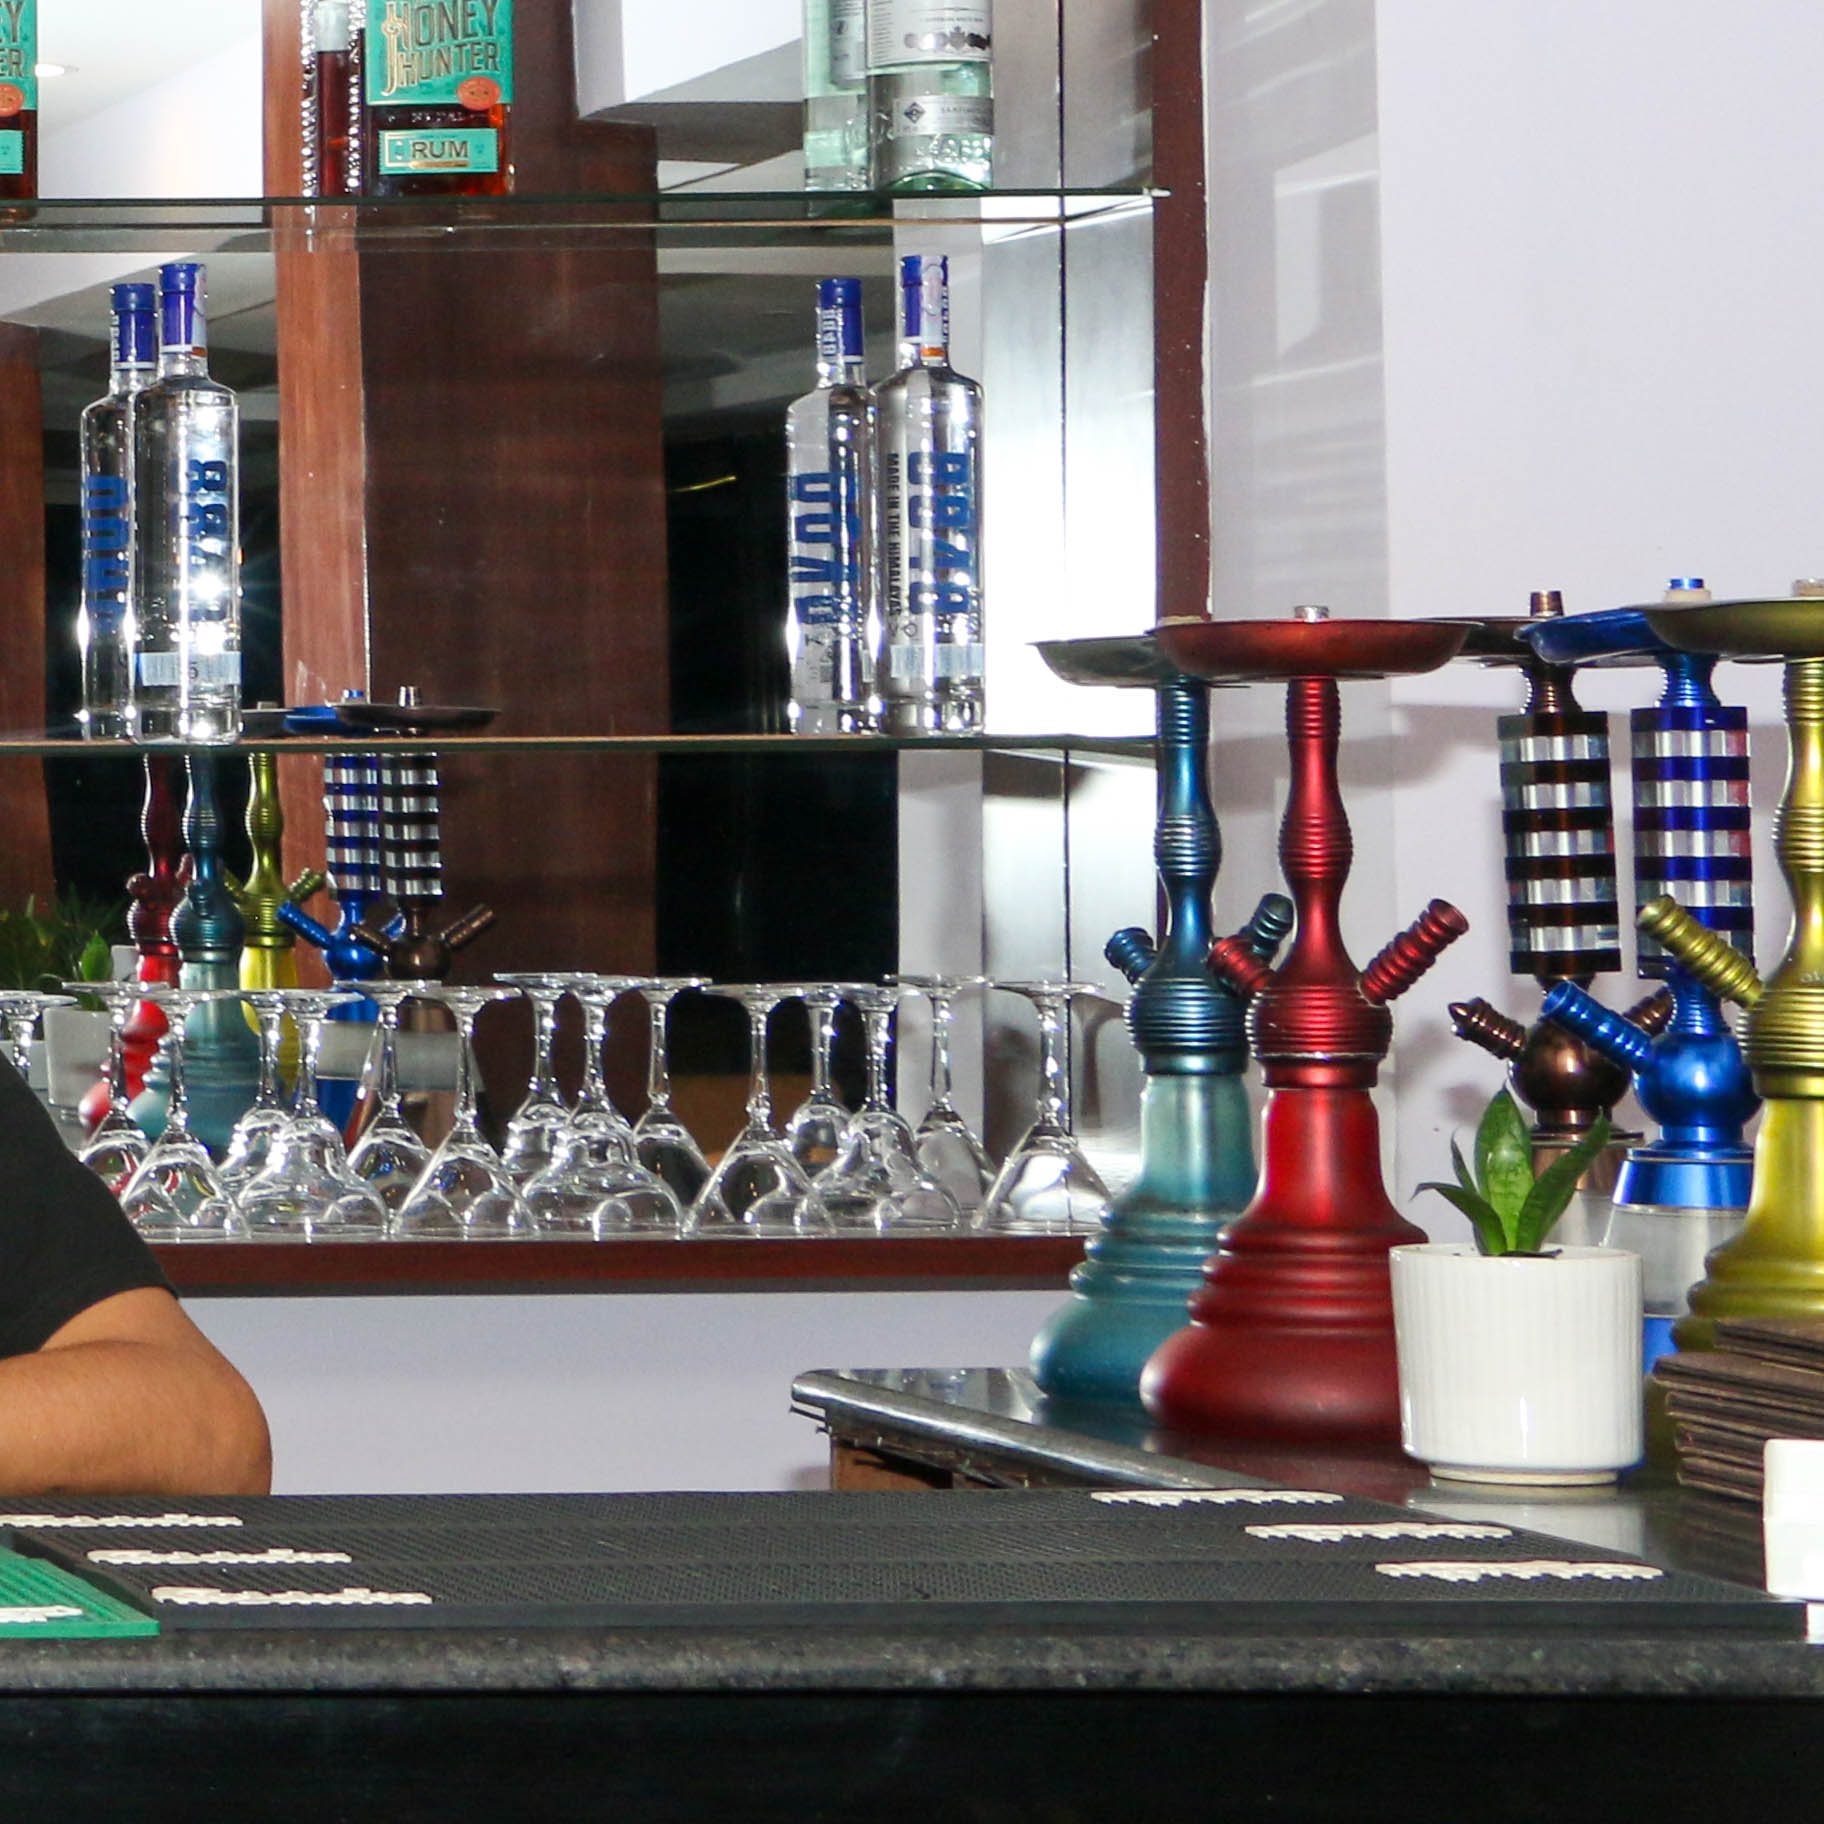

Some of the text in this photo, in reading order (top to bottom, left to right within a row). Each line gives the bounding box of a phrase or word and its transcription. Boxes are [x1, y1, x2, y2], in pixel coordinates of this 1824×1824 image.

[395, 41, 501, 89] HUNTER
[411, 141, 469, 159] RUM
[887, 452, 902, 492] MADE
[887, 496, 901, 510] IN
[887, 514, 901, 538] THE
[908, 451, 971, 615] 8848
